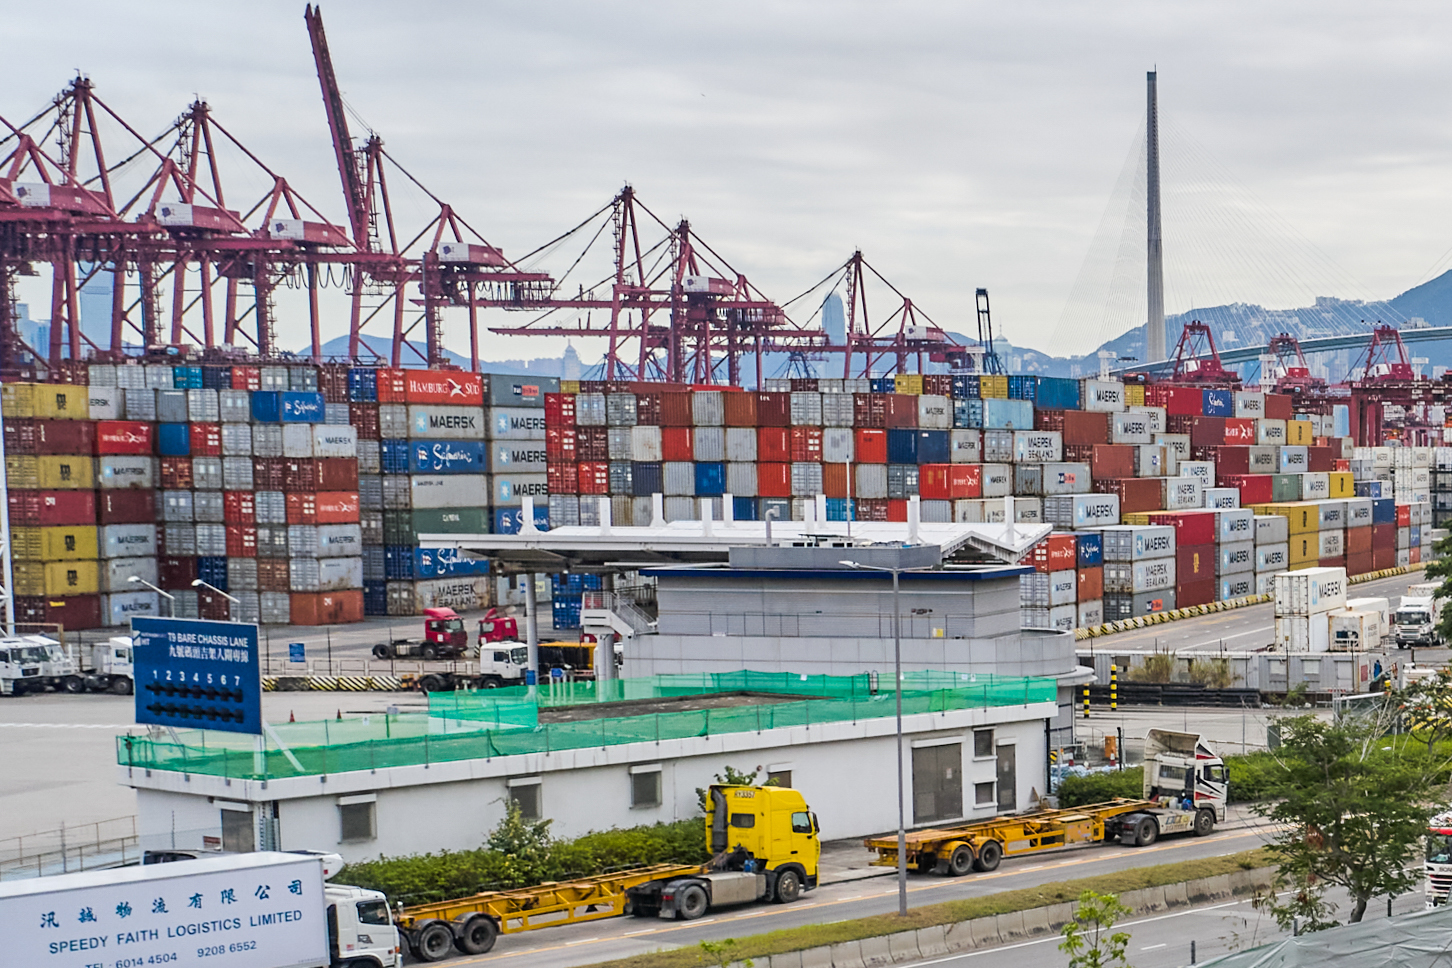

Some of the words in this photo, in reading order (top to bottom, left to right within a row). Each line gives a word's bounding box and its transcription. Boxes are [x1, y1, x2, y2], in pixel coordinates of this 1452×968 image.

[409, 379, 448, 393] HAMBURG
[465, 381, 480, 395] SÜD
[1096, 390, 1120, 402] MAERSK
[429, 416, 476, 429] MAERSK
[1123, 422, 1147, 434] MAERSK
[1028, 437, 1053, 448] MAERSK
[1177, 485, 1196, 495] MAERSK
[1214, 497, 1235, 508] MAERSK
[1086, 504, 1114, 518] MAERSK
[1229, 519, 1250, 532] MAERSK
[1144, 536, 1171, 551] MAERSK
[1229, 550, 1250, 564] MAERSK
[1265, 552, 1285, 565] MAERSK
[1145, 563, 1168, 577] MAERSK
[438, 583, 476, 597] MAERSK
[1229, 581, 1250, 596] MAERSK
[1318, 581, 1343, 598] MAERSK
[168, 632, 176, 642] T9
[177, 633, 197, 644] BARE
[197, 634, 228, 647] CHASSIS
[229, 637, 249, 648] LANE
[166, 670, 172, 680] 2
[179, 671, 185, 681] 3
[193, 673, 199, 682] 4
[207, 673, 213, 684] 5
[221, 675, 227, 685] 6
[234, 676, 240, 686] 7
[49, 935, 108, 954] SPEEDY
[117, 928, 159, 945] FAITH
[167, 917, 242, 939] LOGISTICS
[250, 909, 303, 927] LIMITED
[147, 952, 178, 965] 4504
[197, 944, 226, 958] 9208
[229, 940, 257, 953] 6552
